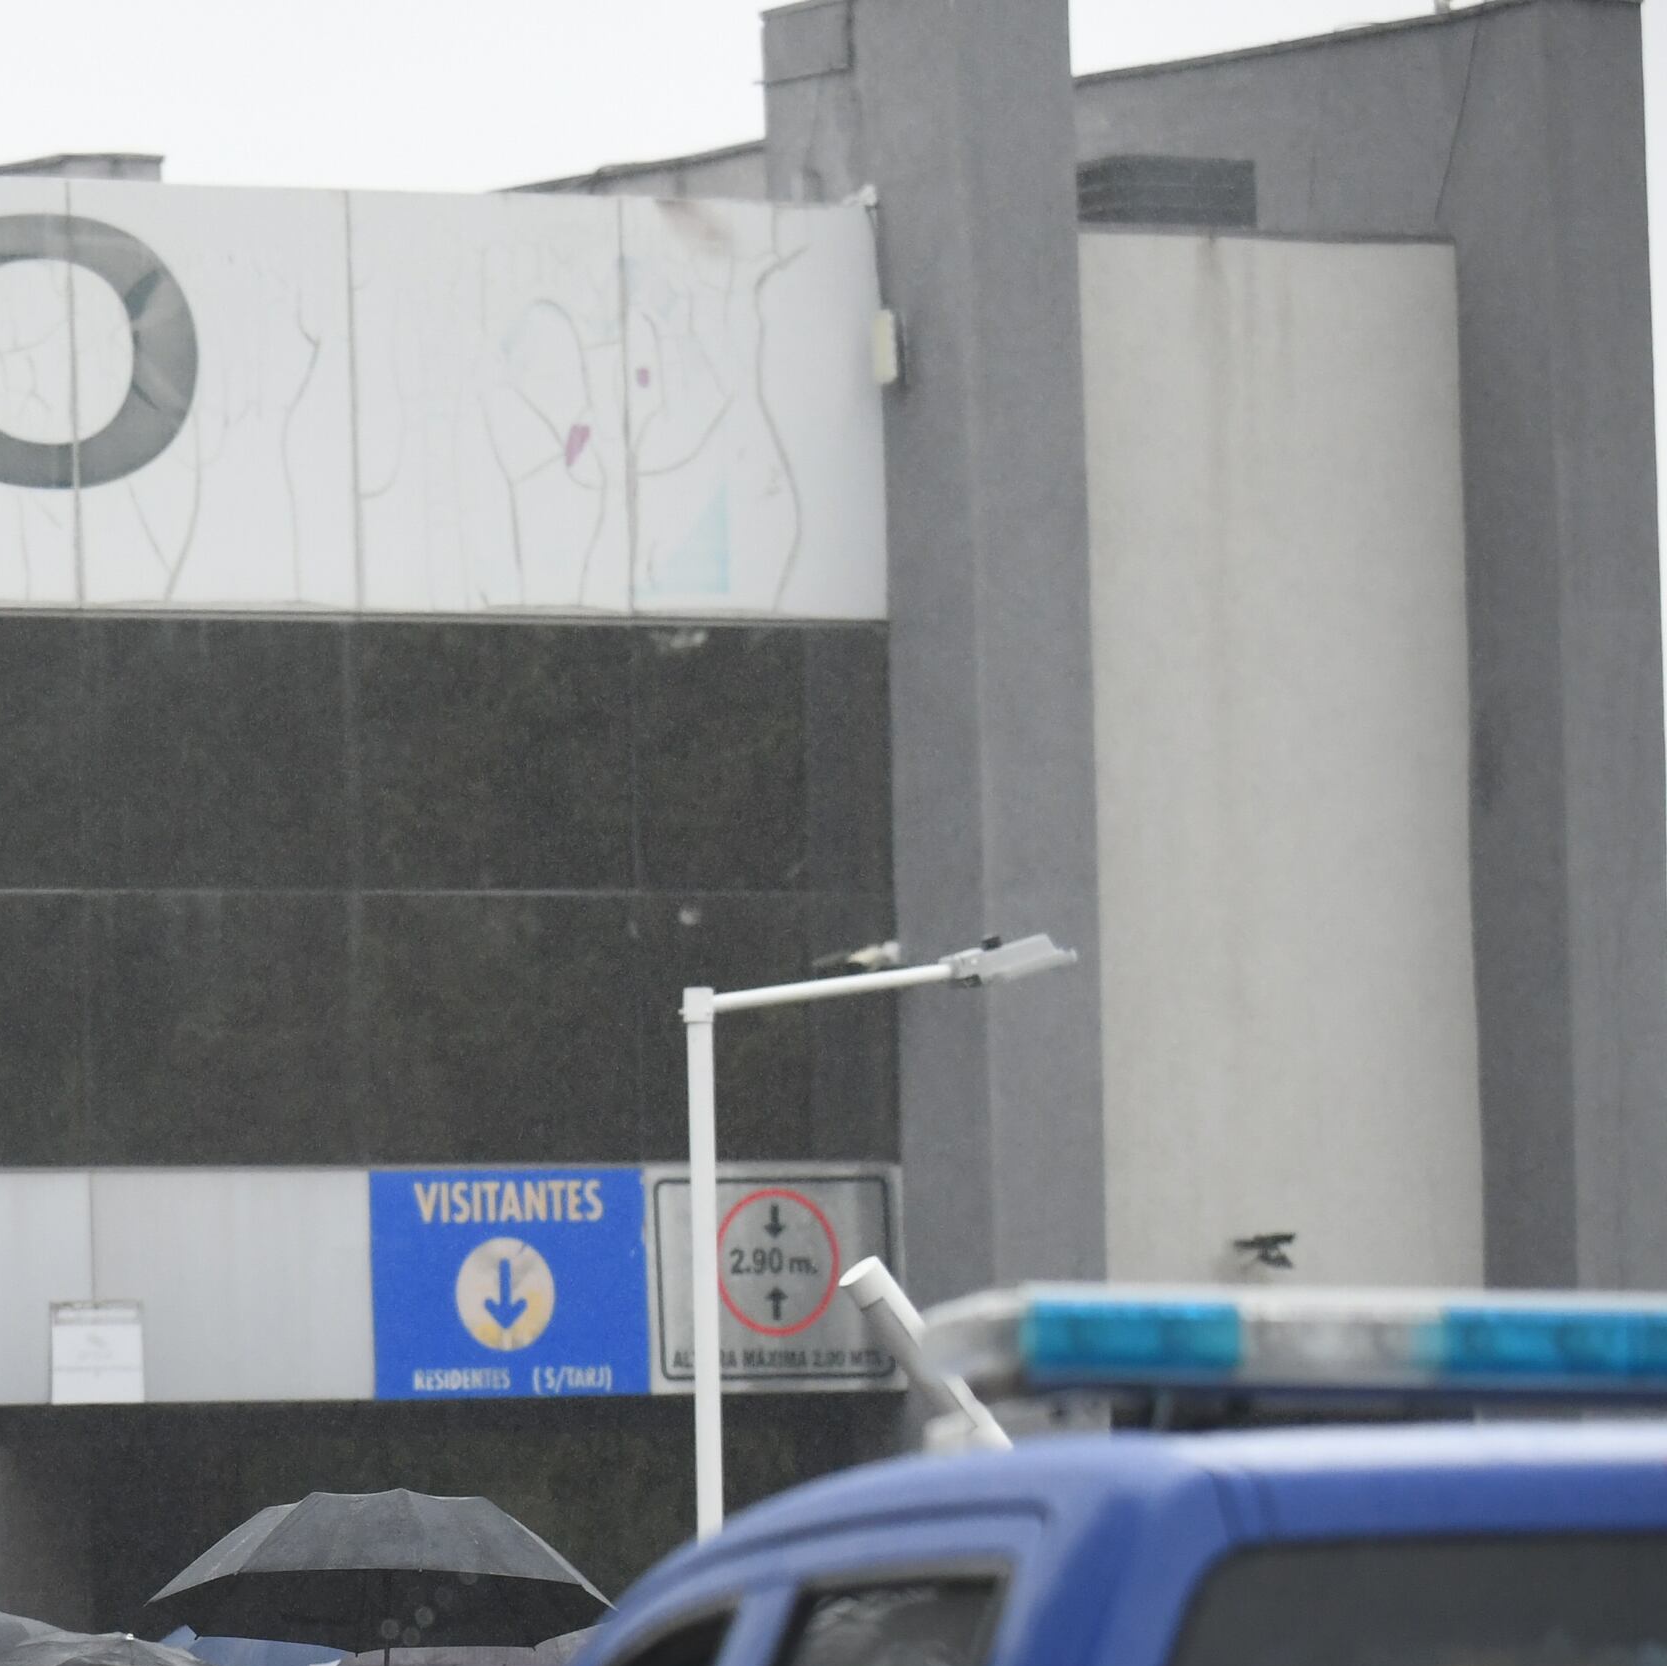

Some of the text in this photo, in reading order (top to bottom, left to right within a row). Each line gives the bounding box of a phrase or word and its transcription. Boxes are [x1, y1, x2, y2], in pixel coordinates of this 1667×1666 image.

[412, 1180, 604, 1224] VISITANTES
[729, 1247, 784, 1275] 2.90
[412, 1368, 511, 1391] RESIDENTES
